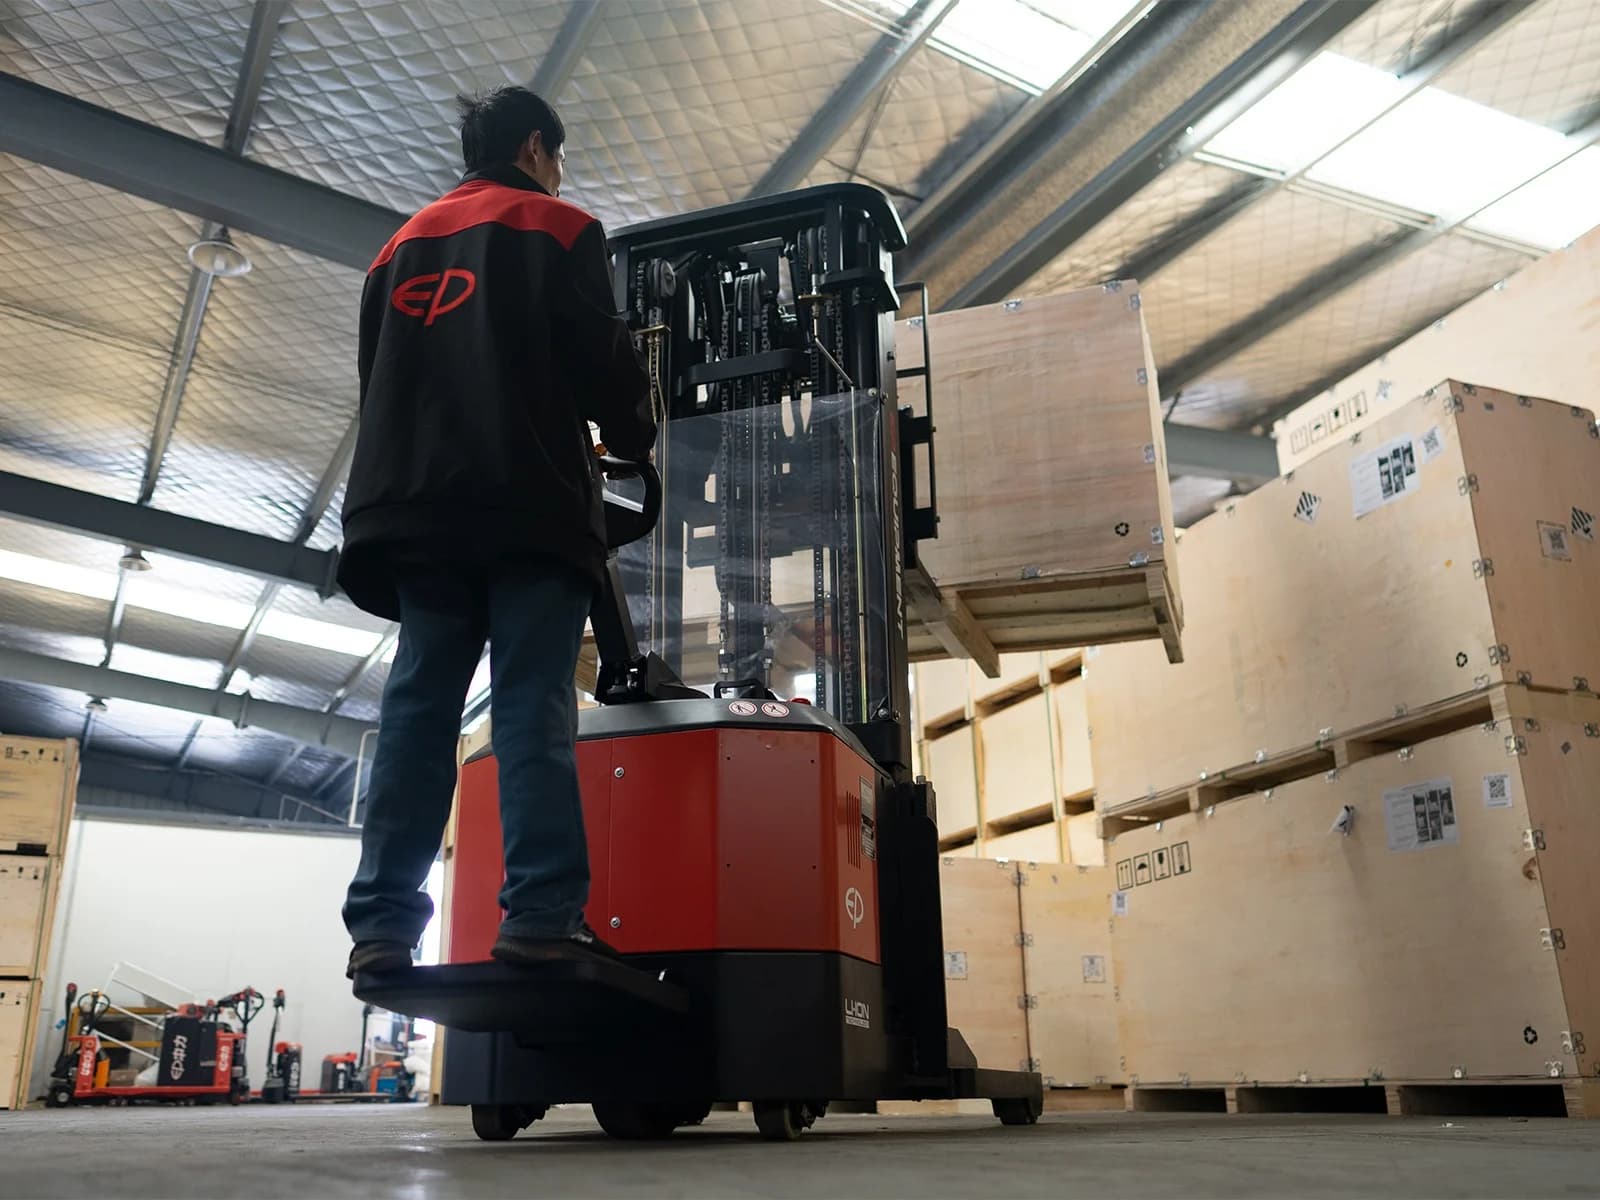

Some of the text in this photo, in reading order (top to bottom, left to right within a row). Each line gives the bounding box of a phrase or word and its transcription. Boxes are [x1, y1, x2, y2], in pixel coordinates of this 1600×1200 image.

[391, 268, 476, 327] EP
[890, 452, 904, 640] EQUIPMENT
[845, 887, 864, 929] EP
